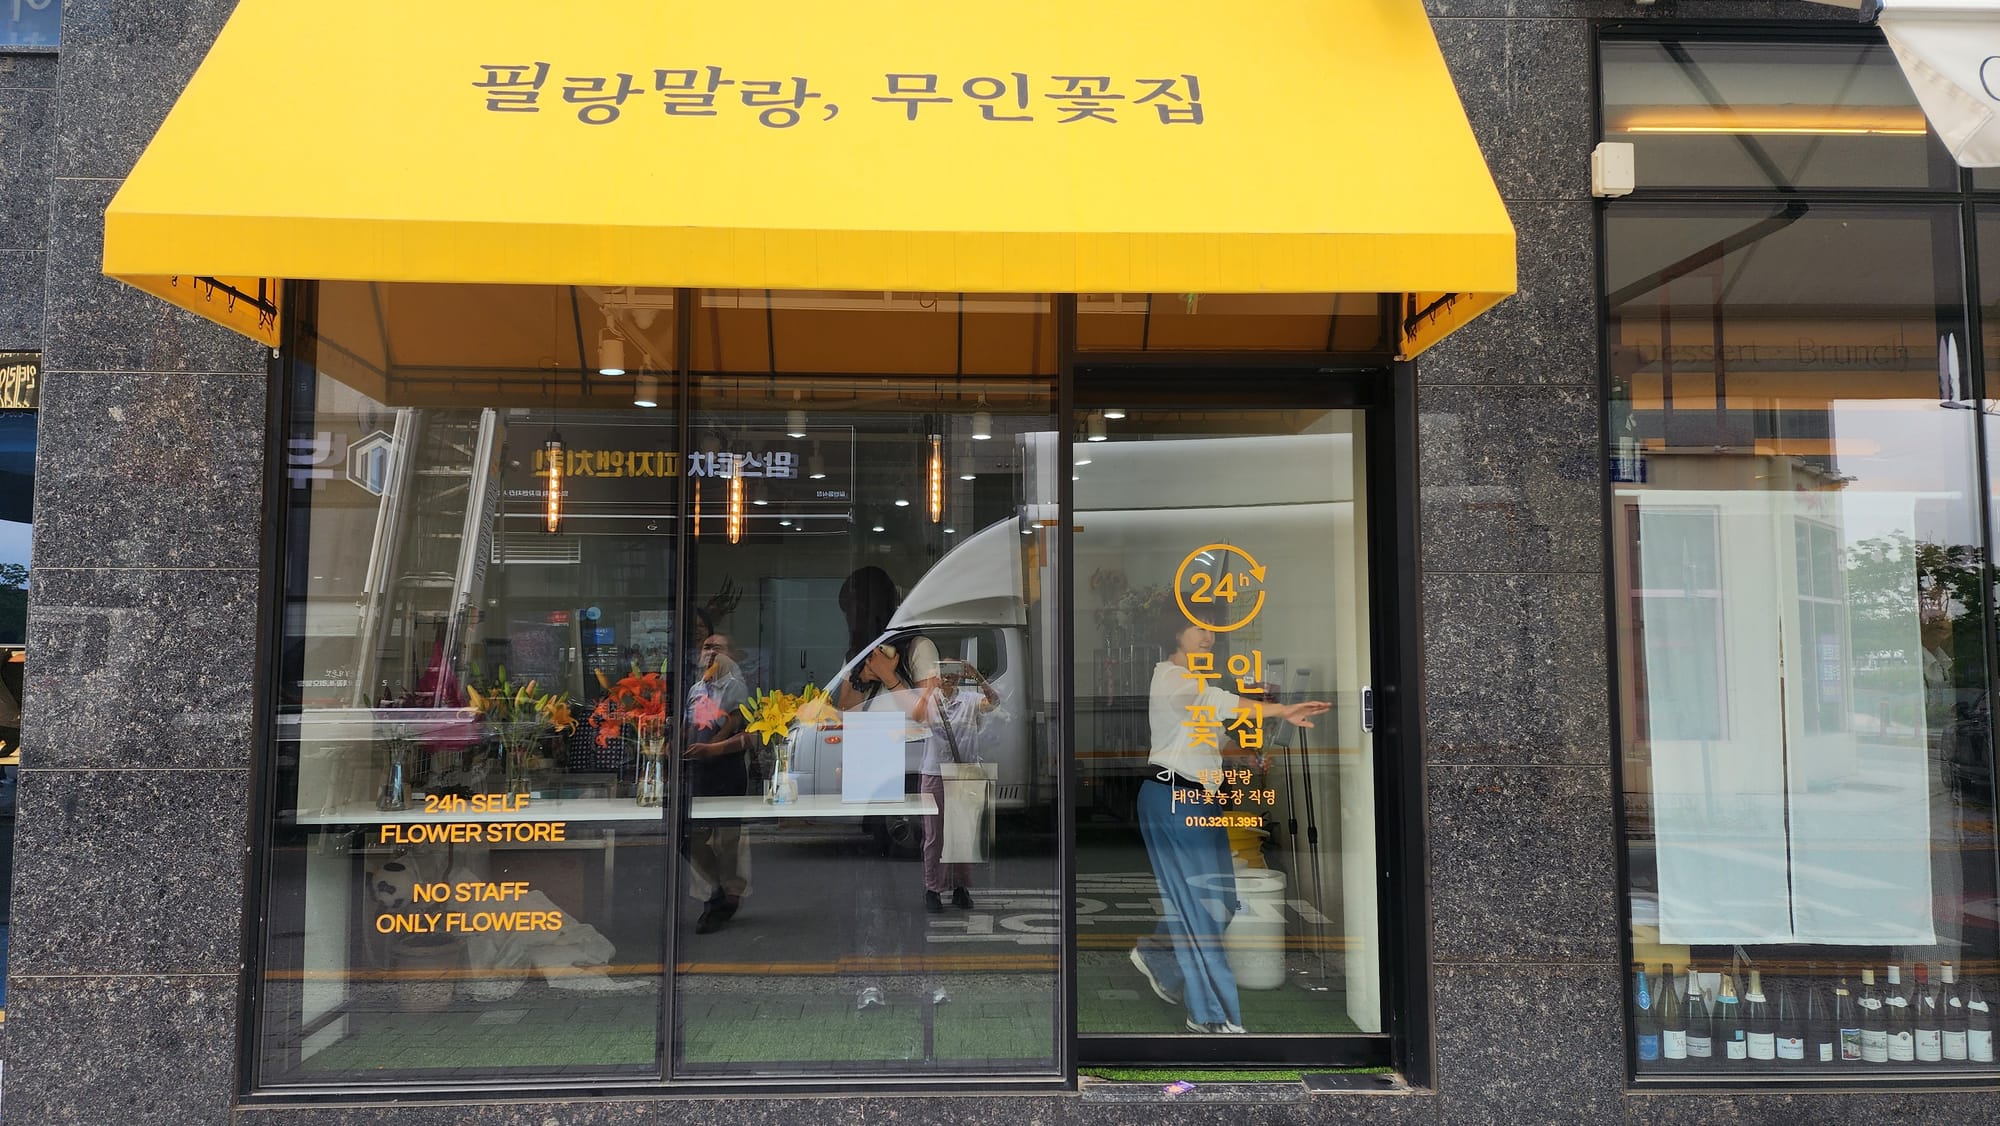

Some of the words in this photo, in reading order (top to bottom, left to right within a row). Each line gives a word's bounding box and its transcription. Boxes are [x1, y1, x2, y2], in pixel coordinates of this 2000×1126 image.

[472, 62, 839, 128] 필랑말랑,
[872, 72, 1204, 125] 무인꽃집
[1190, 571, 1250, 603] 24h
[1181, 650, 1265, 694] 무인
[1181, 703, 1265, 749] 꽃집
[424, 793, 467, 814] 24h
[471, 793, 530, 813] SELF
[1174, 788, 1245, 805] 태안꽃농장
[1248, 788, 1276, 805] 직영
[1185, 816, 1263, 827] 010.3261.3951
[380, 824, 482, 844] FLOWER
[486, 822, 566, 843] STORE
[413, 883, 451, 903] NO
[454, 882, 530, 902] STAFF
[376, 913, 442, 933] ONLY
[446, 911, 562, 932] FLOWERS
